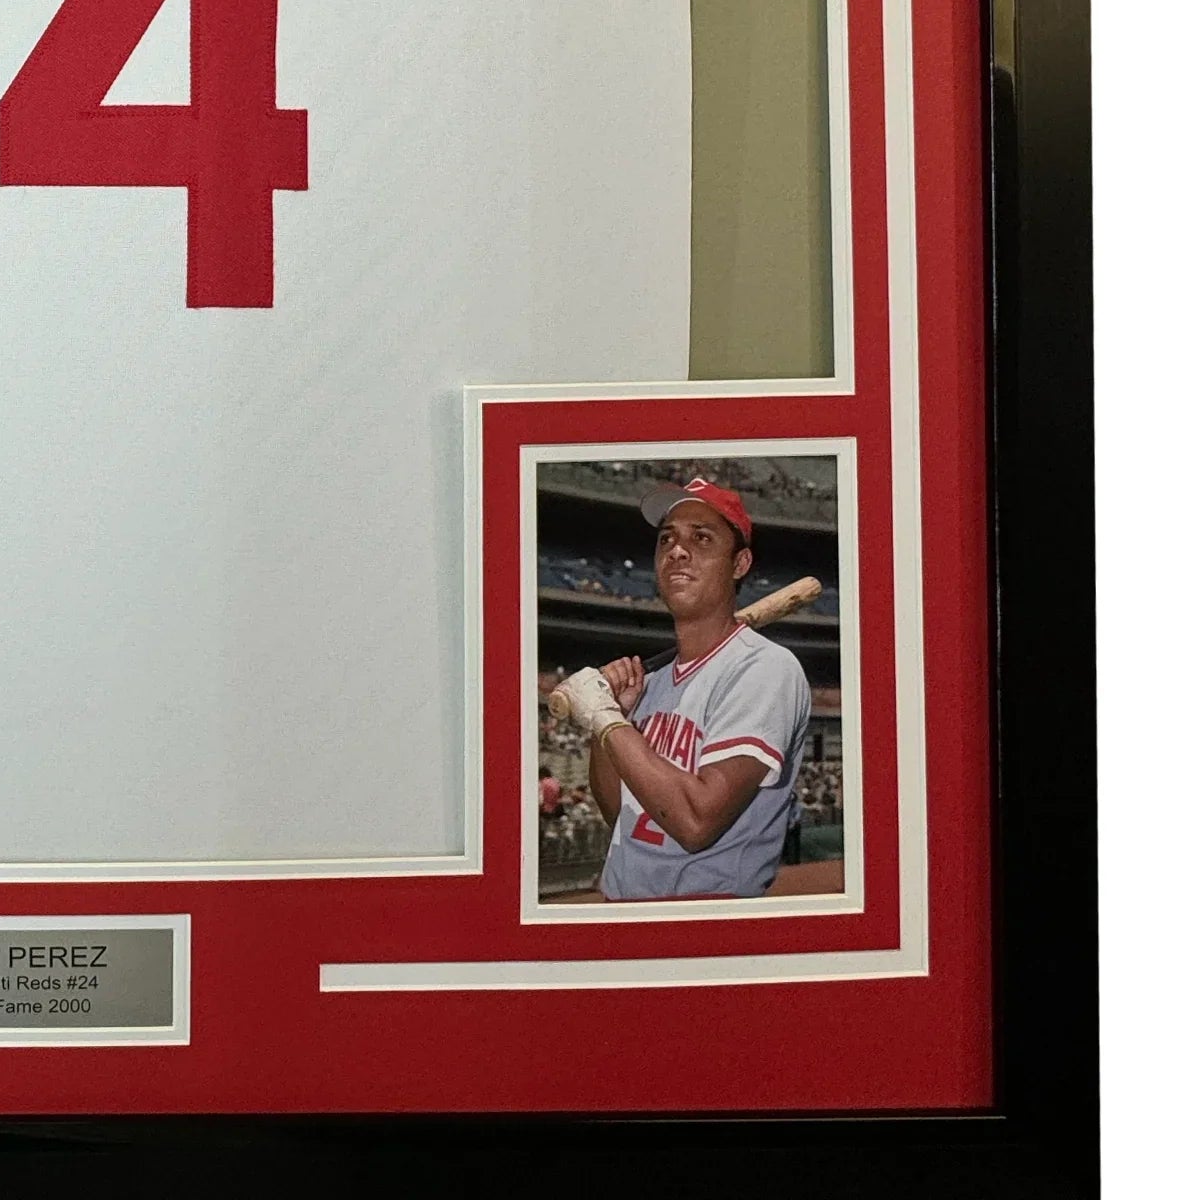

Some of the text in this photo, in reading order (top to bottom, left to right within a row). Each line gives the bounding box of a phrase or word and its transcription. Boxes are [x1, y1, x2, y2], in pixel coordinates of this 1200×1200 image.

[8, 945, 108, 968] PEREZ
[16, 975, 62, 991] Reds
[66, 975, 99, 990] #24
[48, 998, 92, 1013] 2000
